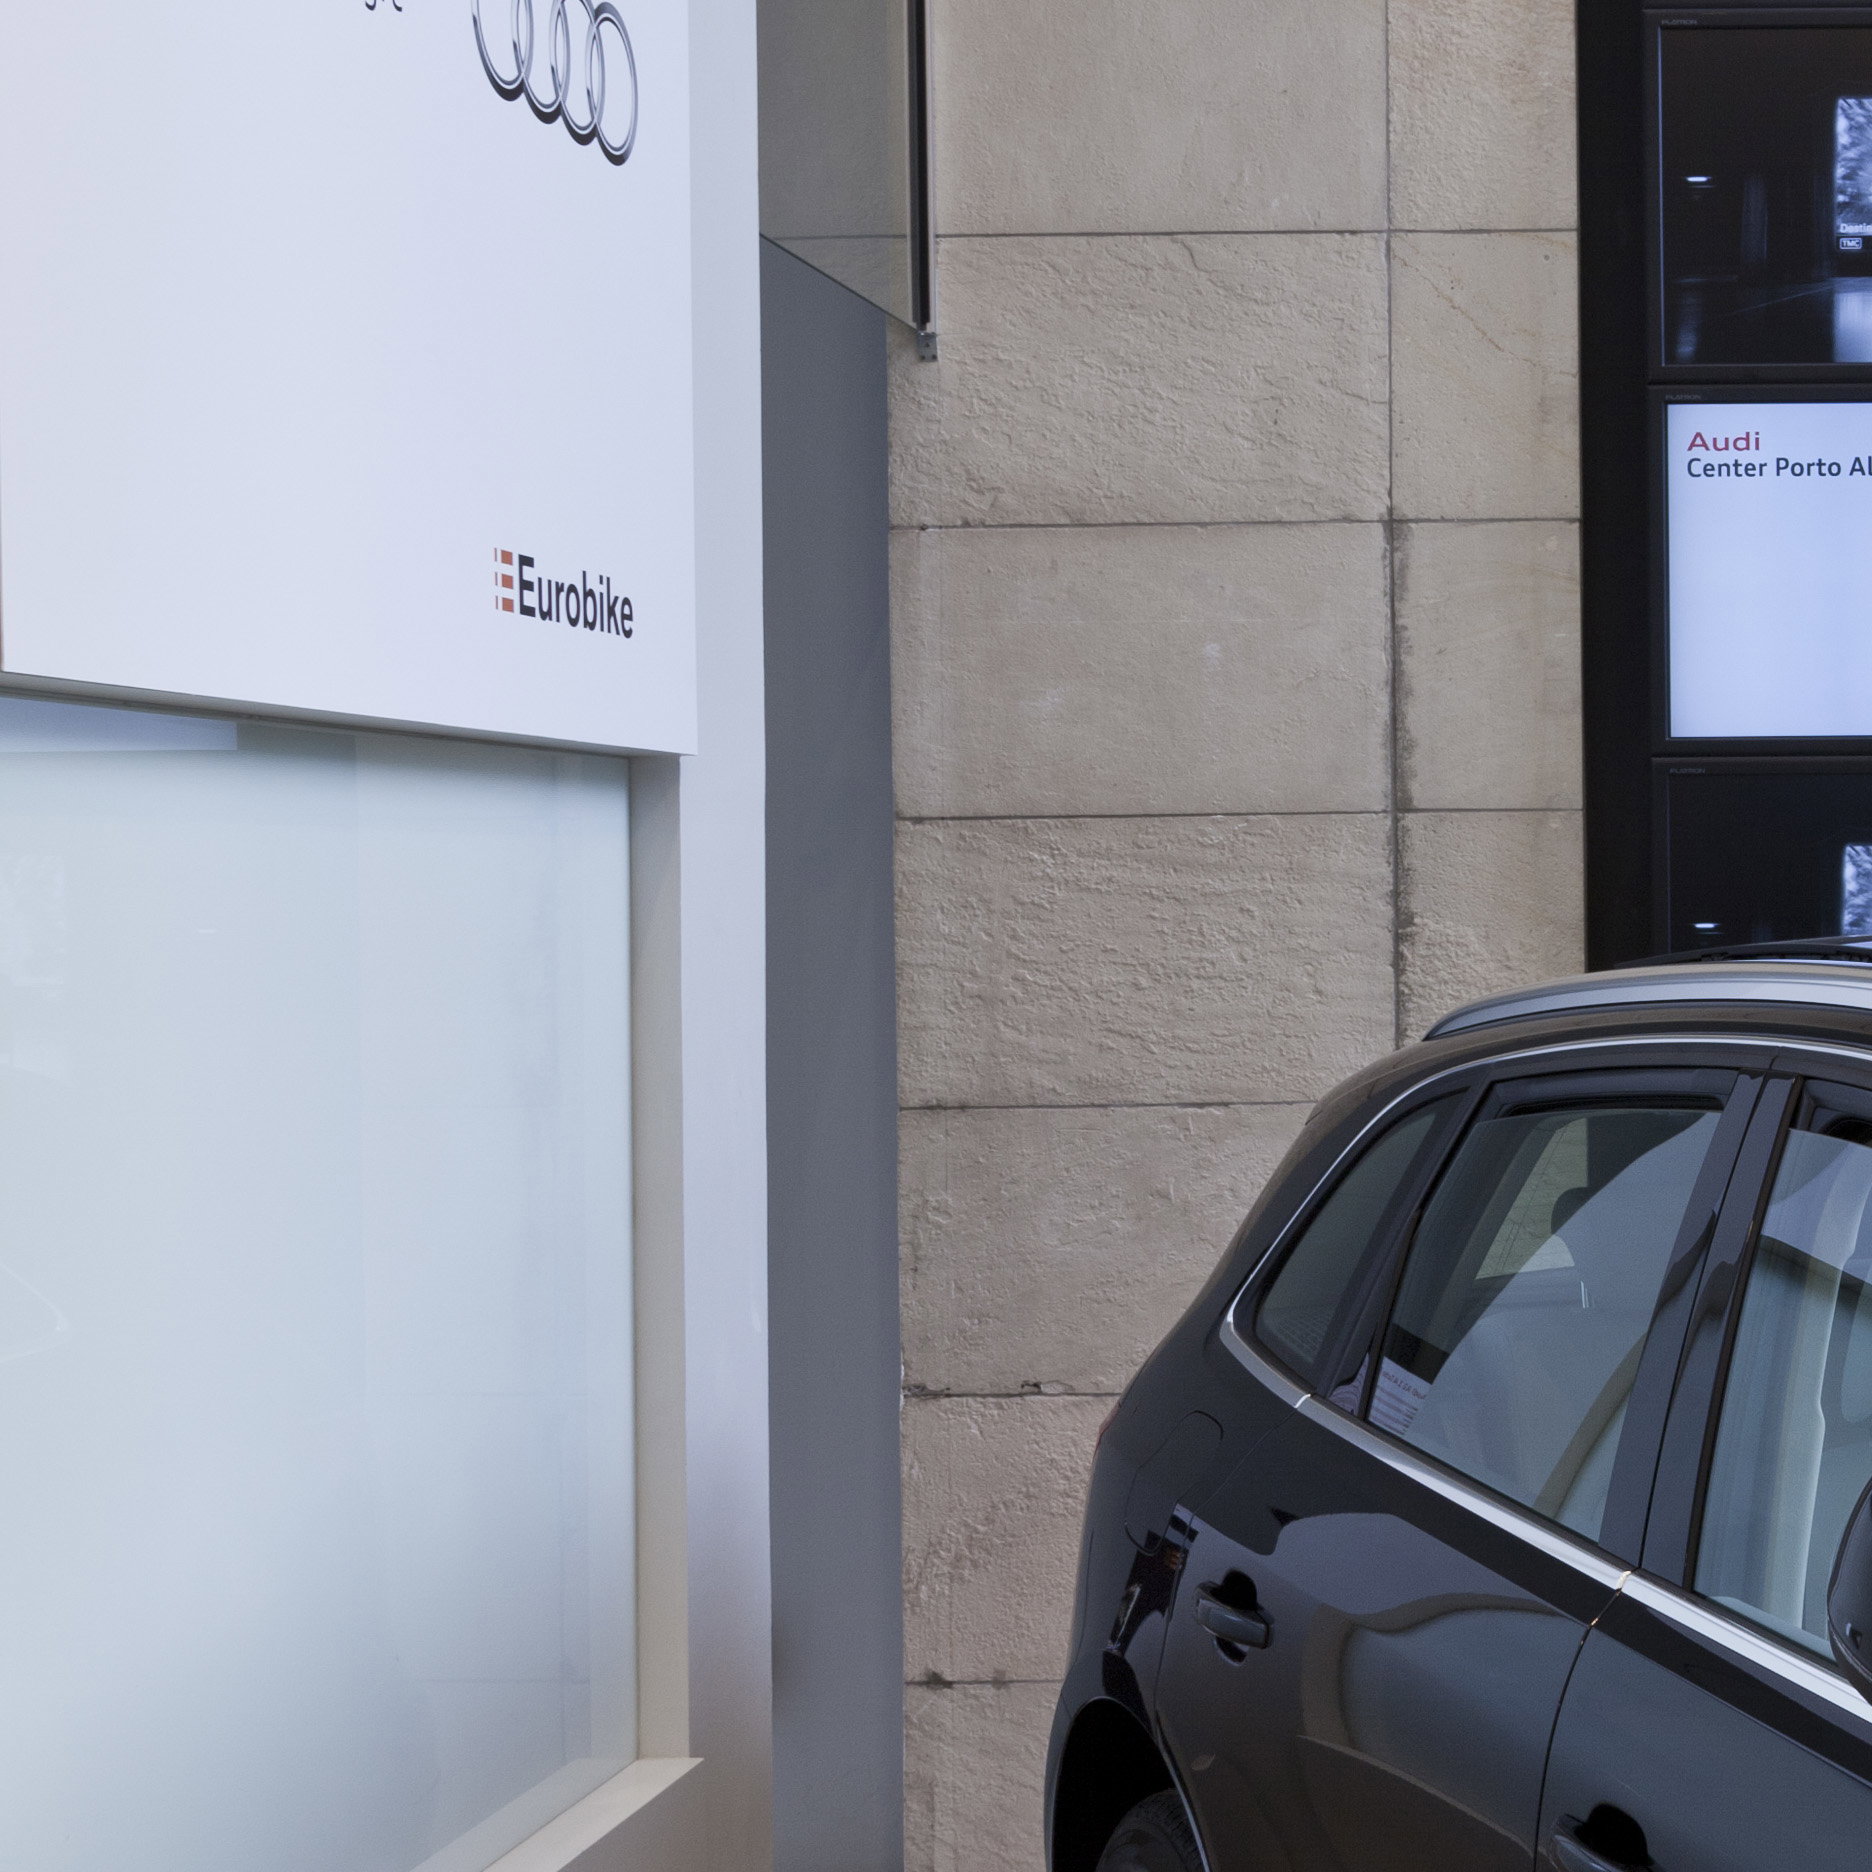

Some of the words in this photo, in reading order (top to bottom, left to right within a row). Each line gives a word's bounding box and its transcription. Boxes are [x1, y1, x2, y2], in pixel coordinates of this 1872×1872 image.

[1686, 431, 1760, 452] Audi
[1686, 457, 1768, 478] Center
[1775, 456, 1842, 478] Porto
[517, 553, 634, 640] Eurobike
